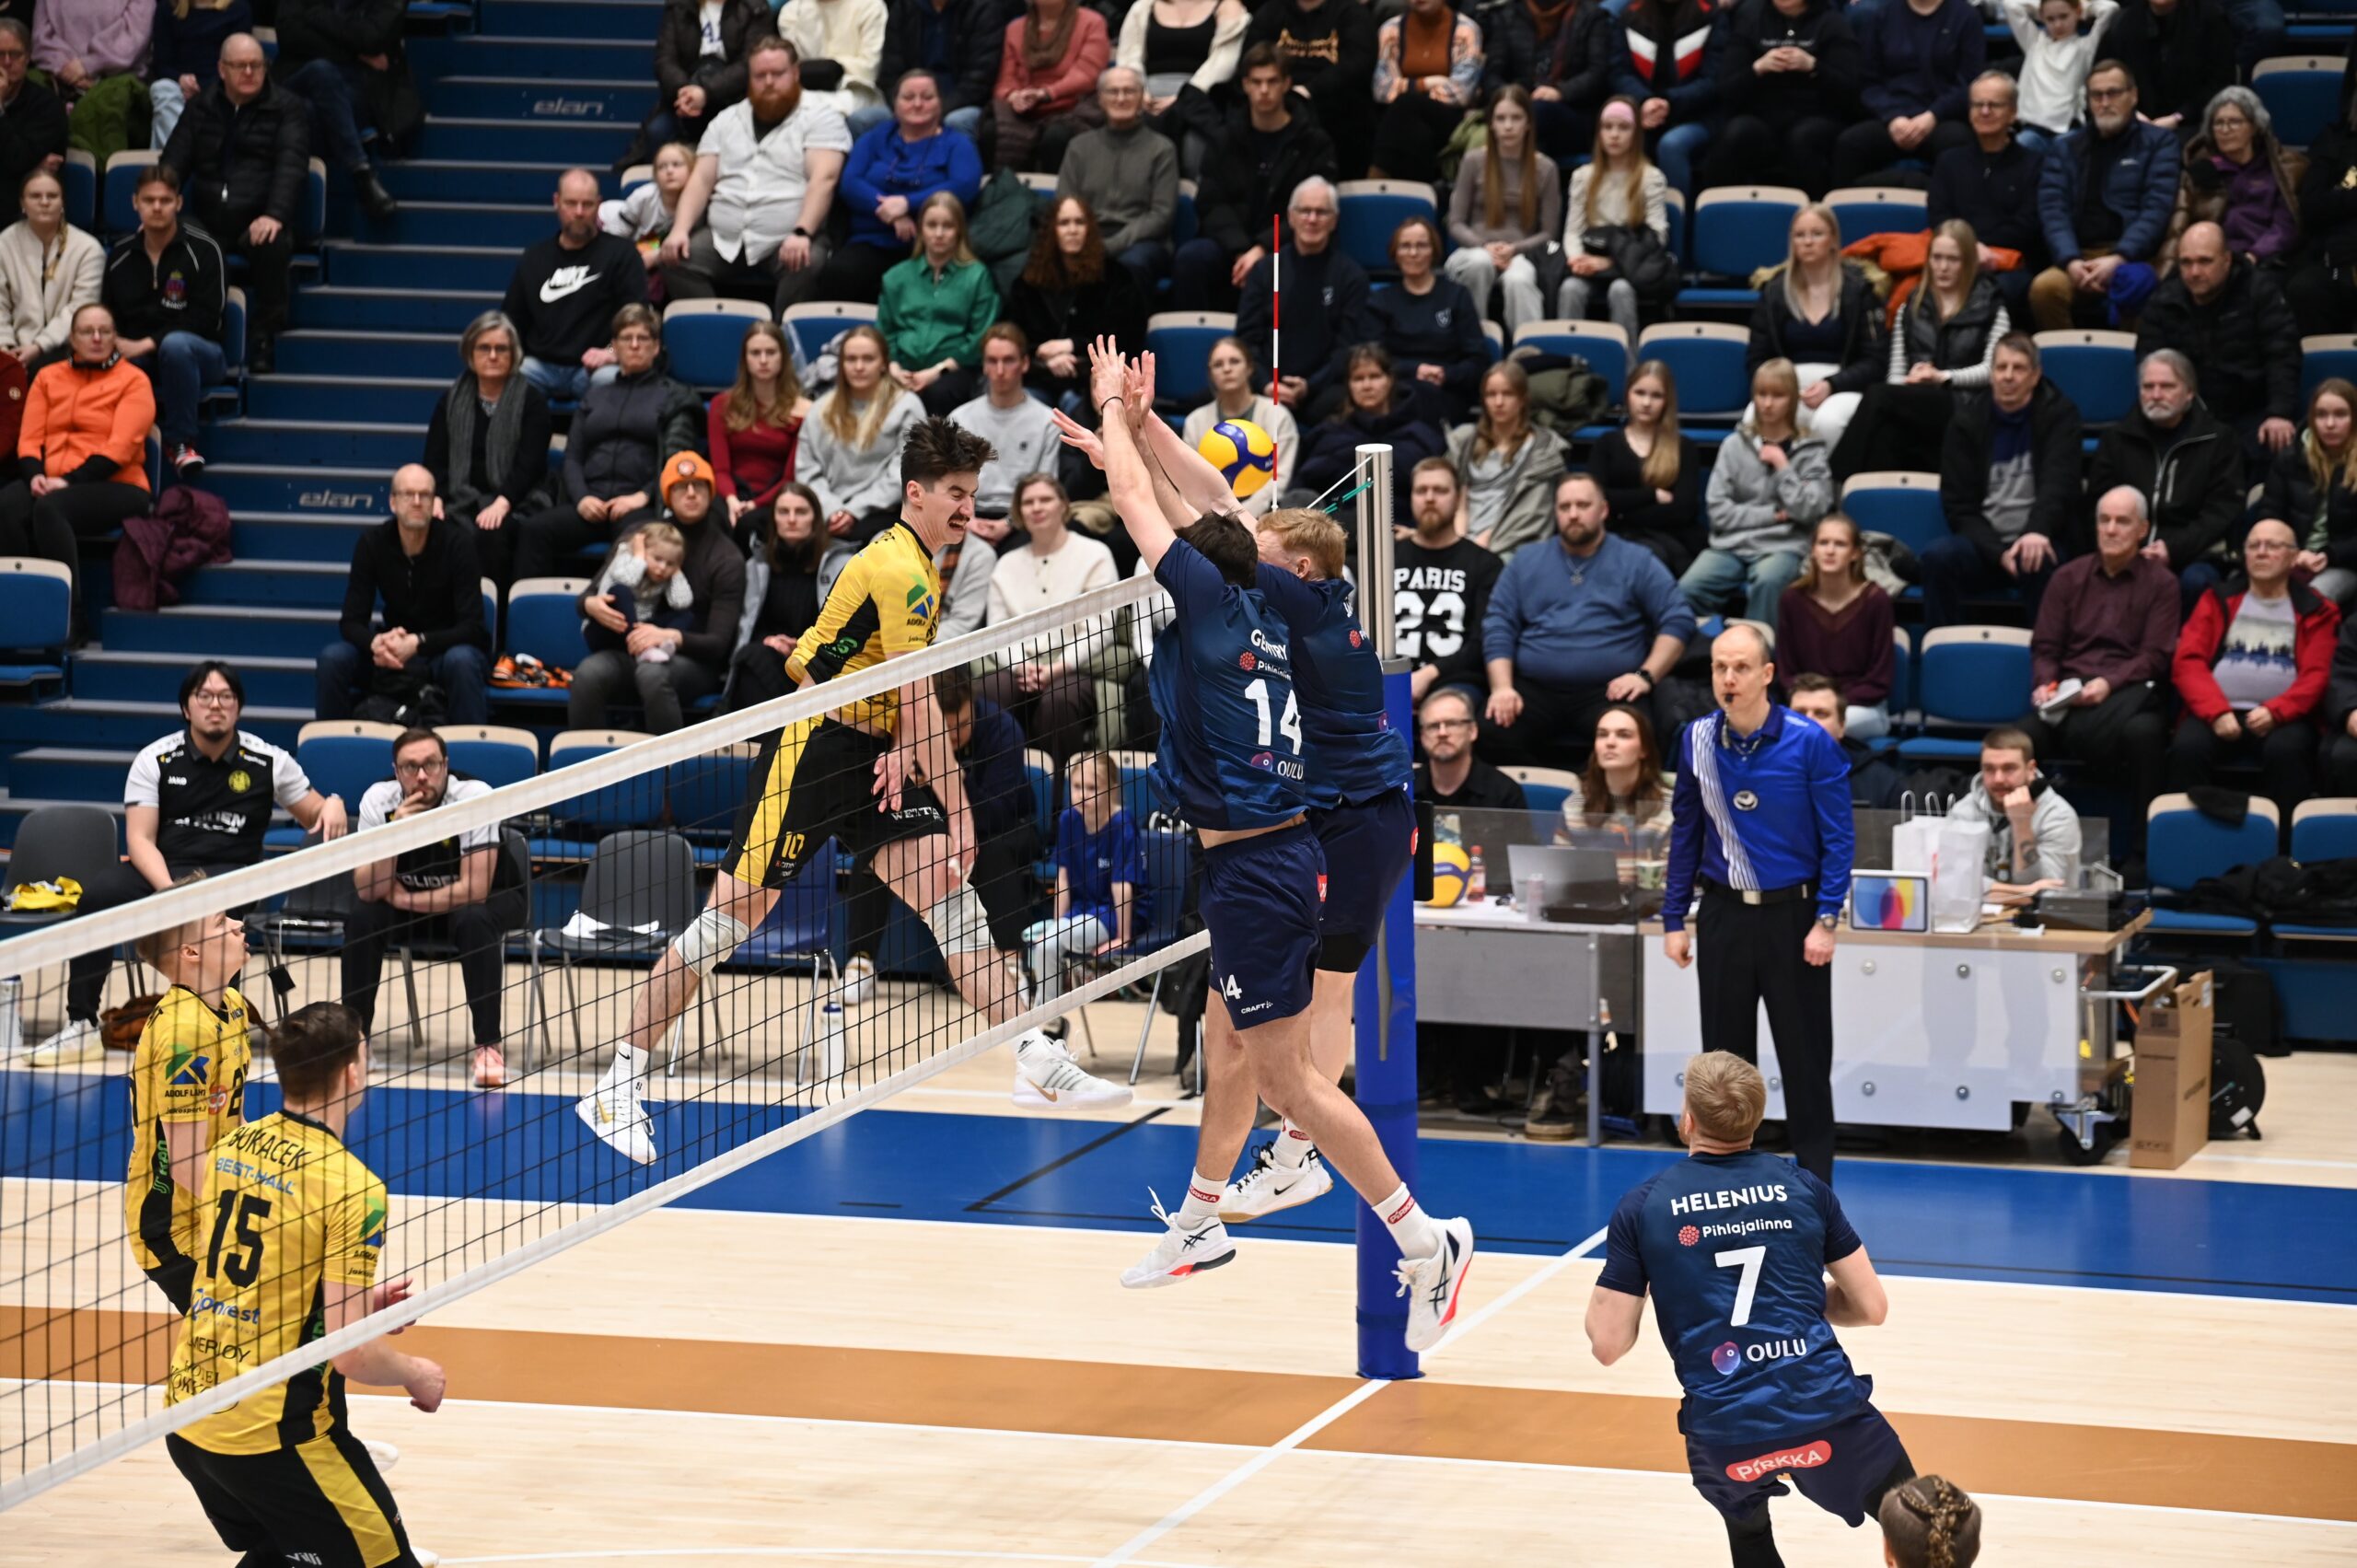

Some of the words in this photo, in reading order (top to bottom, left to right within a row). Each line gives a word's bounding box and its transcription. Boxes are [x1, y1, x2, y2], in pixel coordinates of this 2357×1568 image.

[299, 489, 373, 508] elan
[1394, 566, 1466, 593] PARIS
[1395, 591, 1466, 657] 23
[1245, 679, 1302, 756] 14
[1277, 761, 1304, 780] OULU
[782, 831, 806, 859] 10
[1240, 1003, 1266, 1015] CRAFT
[215, 1157, 295, 1196] BEST-HALL
[1671, 1185, 1788, 1215] HELENIUS
[206, 1189, 273, 1288] 15
[1702, 1219, 1793, 1237] Pihlajalinna
[1715, 1245, 1767, 1328] 7
[1747, 1338, 1807, 1362] OULU
